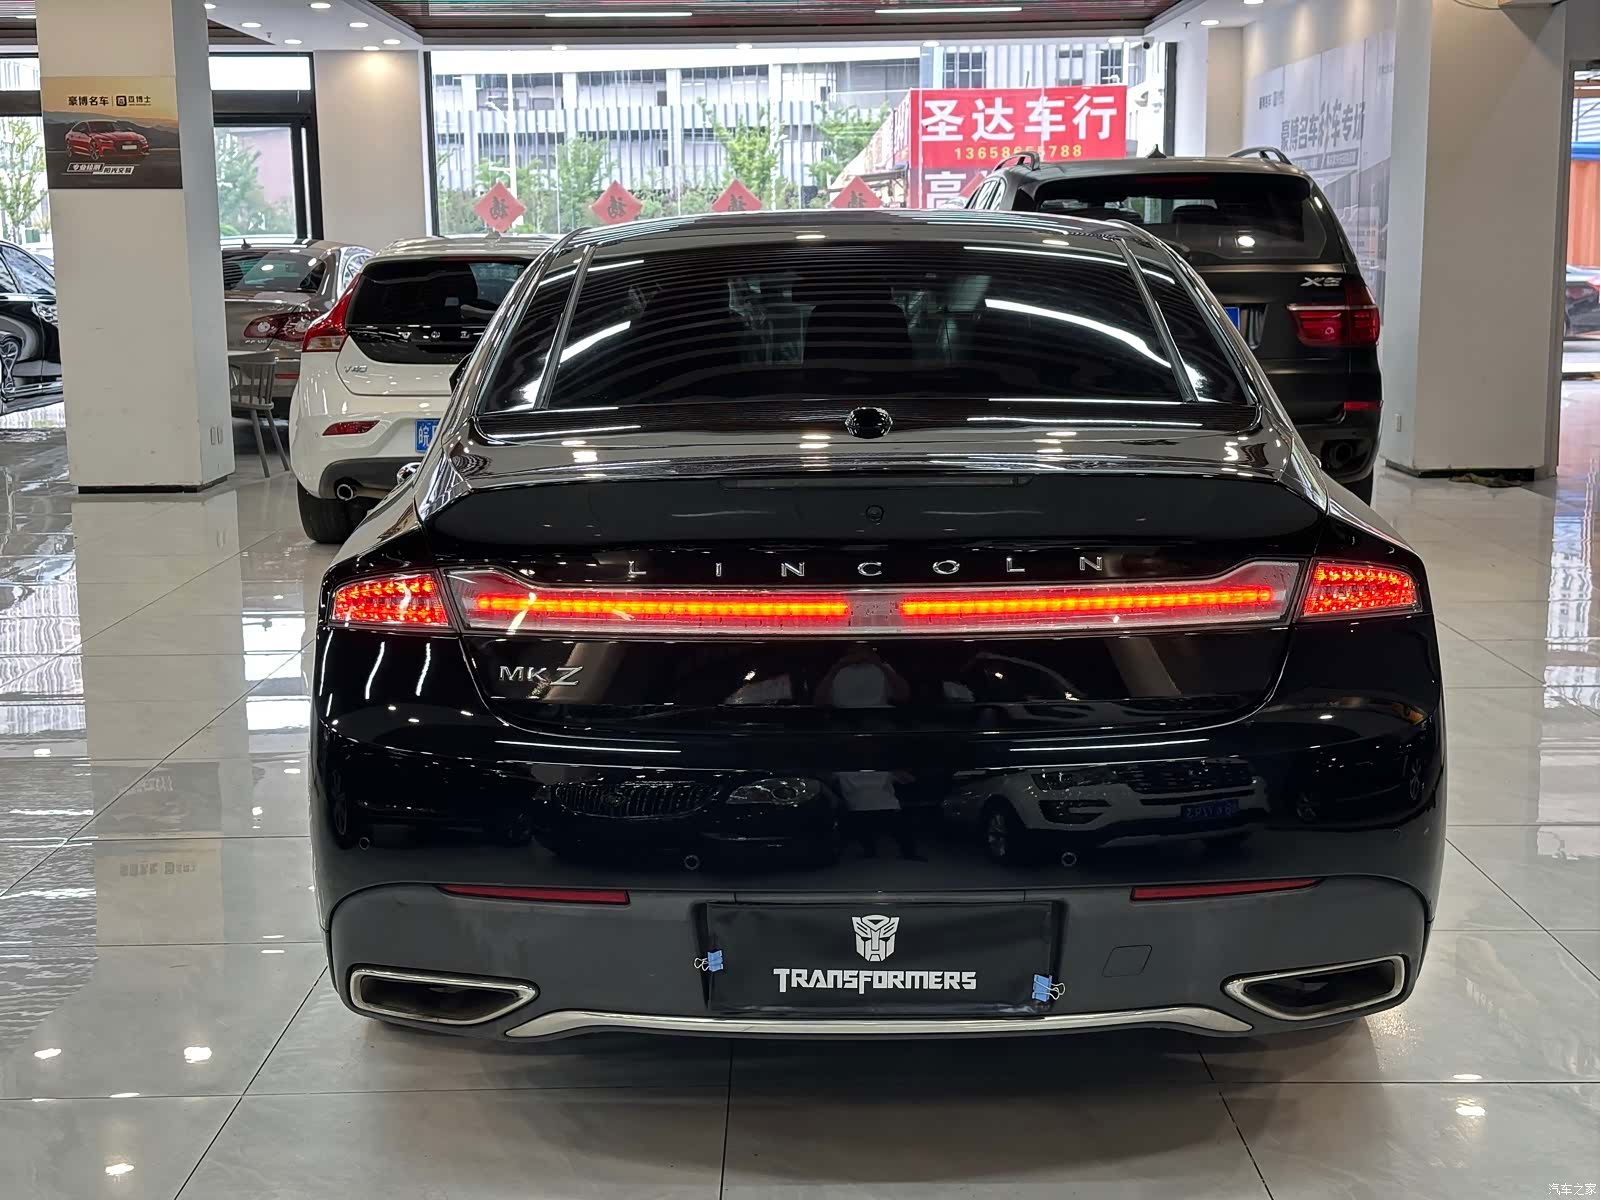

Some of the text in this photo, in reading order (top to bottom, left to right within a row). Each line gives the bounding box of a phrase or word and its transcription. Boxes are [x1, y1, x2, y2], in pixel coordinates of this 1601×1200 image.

[68, 95, 109, 107] 豪博名车
[921, 94, 1118, 142] 圣达车行
[628, 555, 1103, 578] LINCOLN
[499, 665, 583, 686] MKZ
[773, 968, 977, 995] TRANSFORMERS
